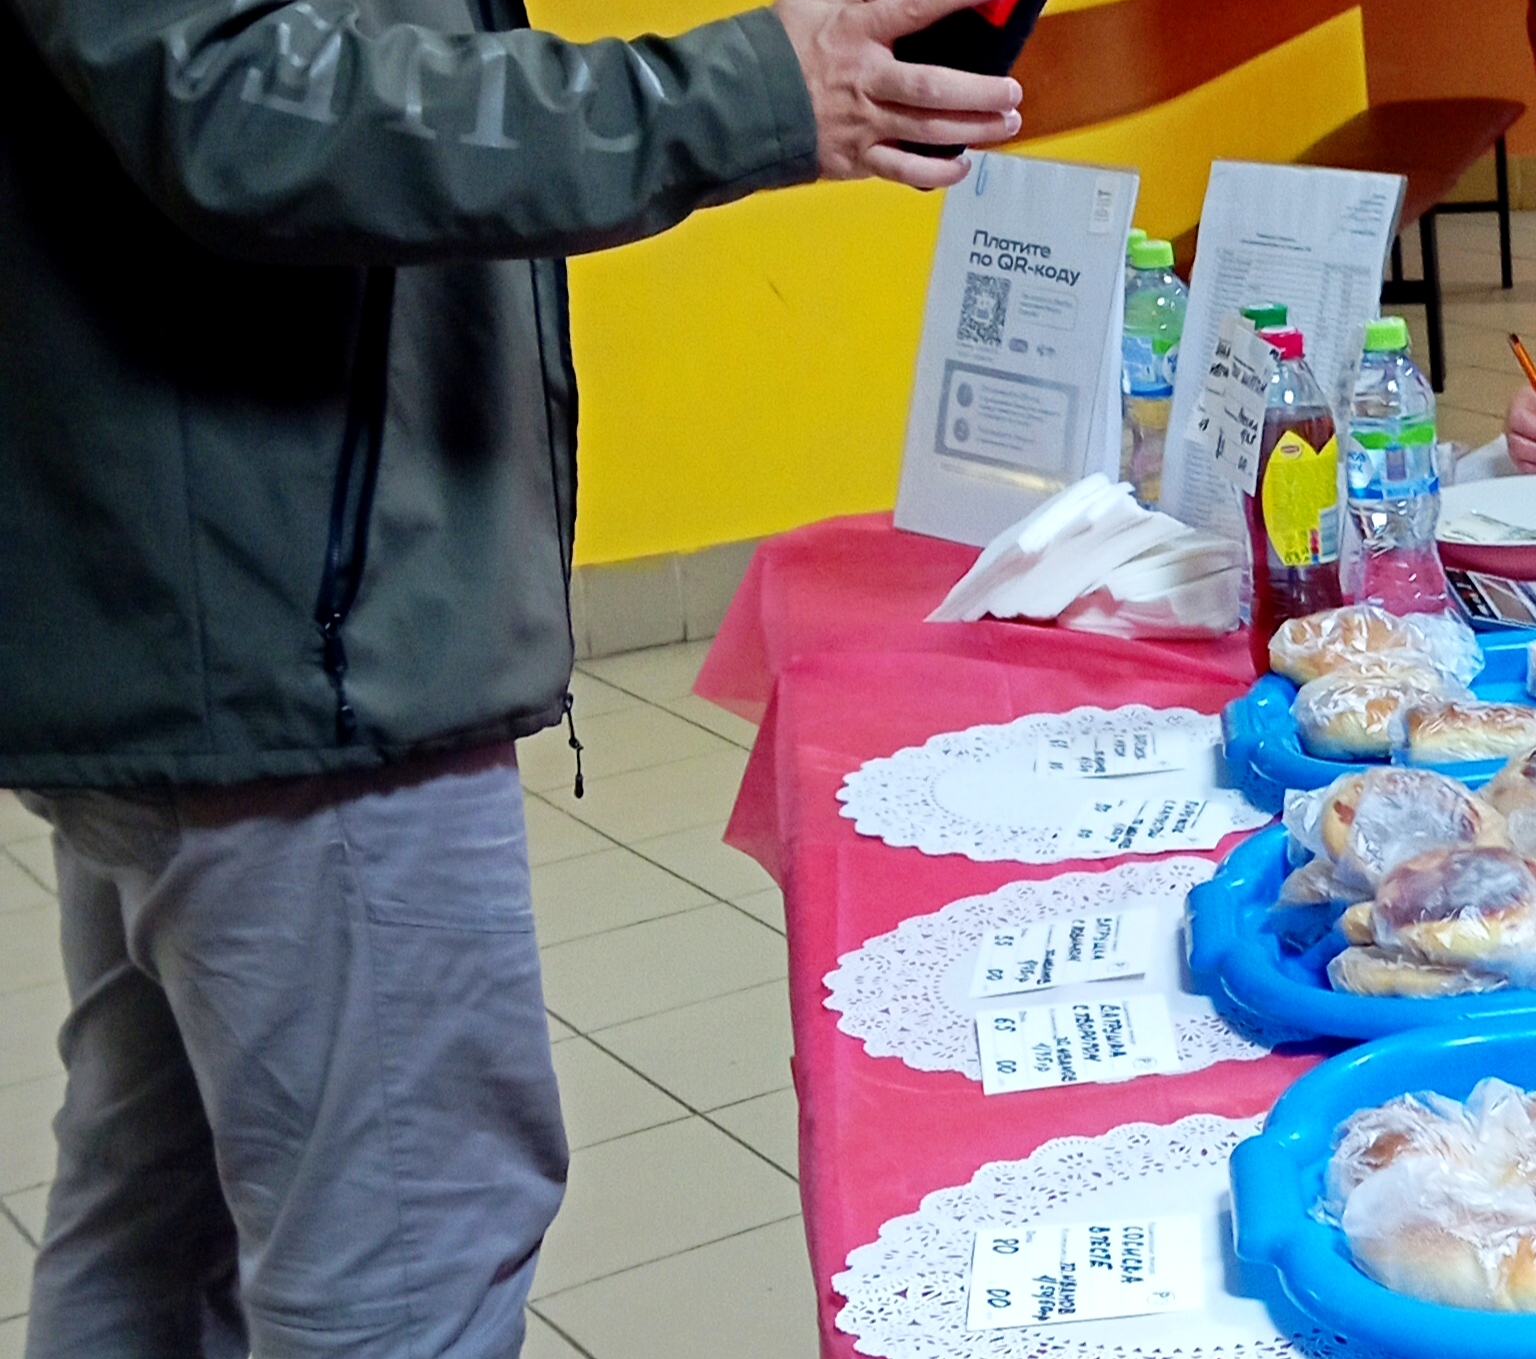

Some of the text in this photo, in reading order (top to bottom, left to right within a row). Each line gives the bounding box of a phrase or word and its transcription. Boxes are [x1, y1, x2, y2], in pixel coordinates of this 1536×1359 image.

[972, 229, 1051, 258] Платите
[969, 251, 1081, 286] по QR-коду
[994, 1017, 1017, 1074] 65 00
[1120, 1226, 1144, 1283] СОСИСКА
[986, 1289, 1011, 1308] 00
